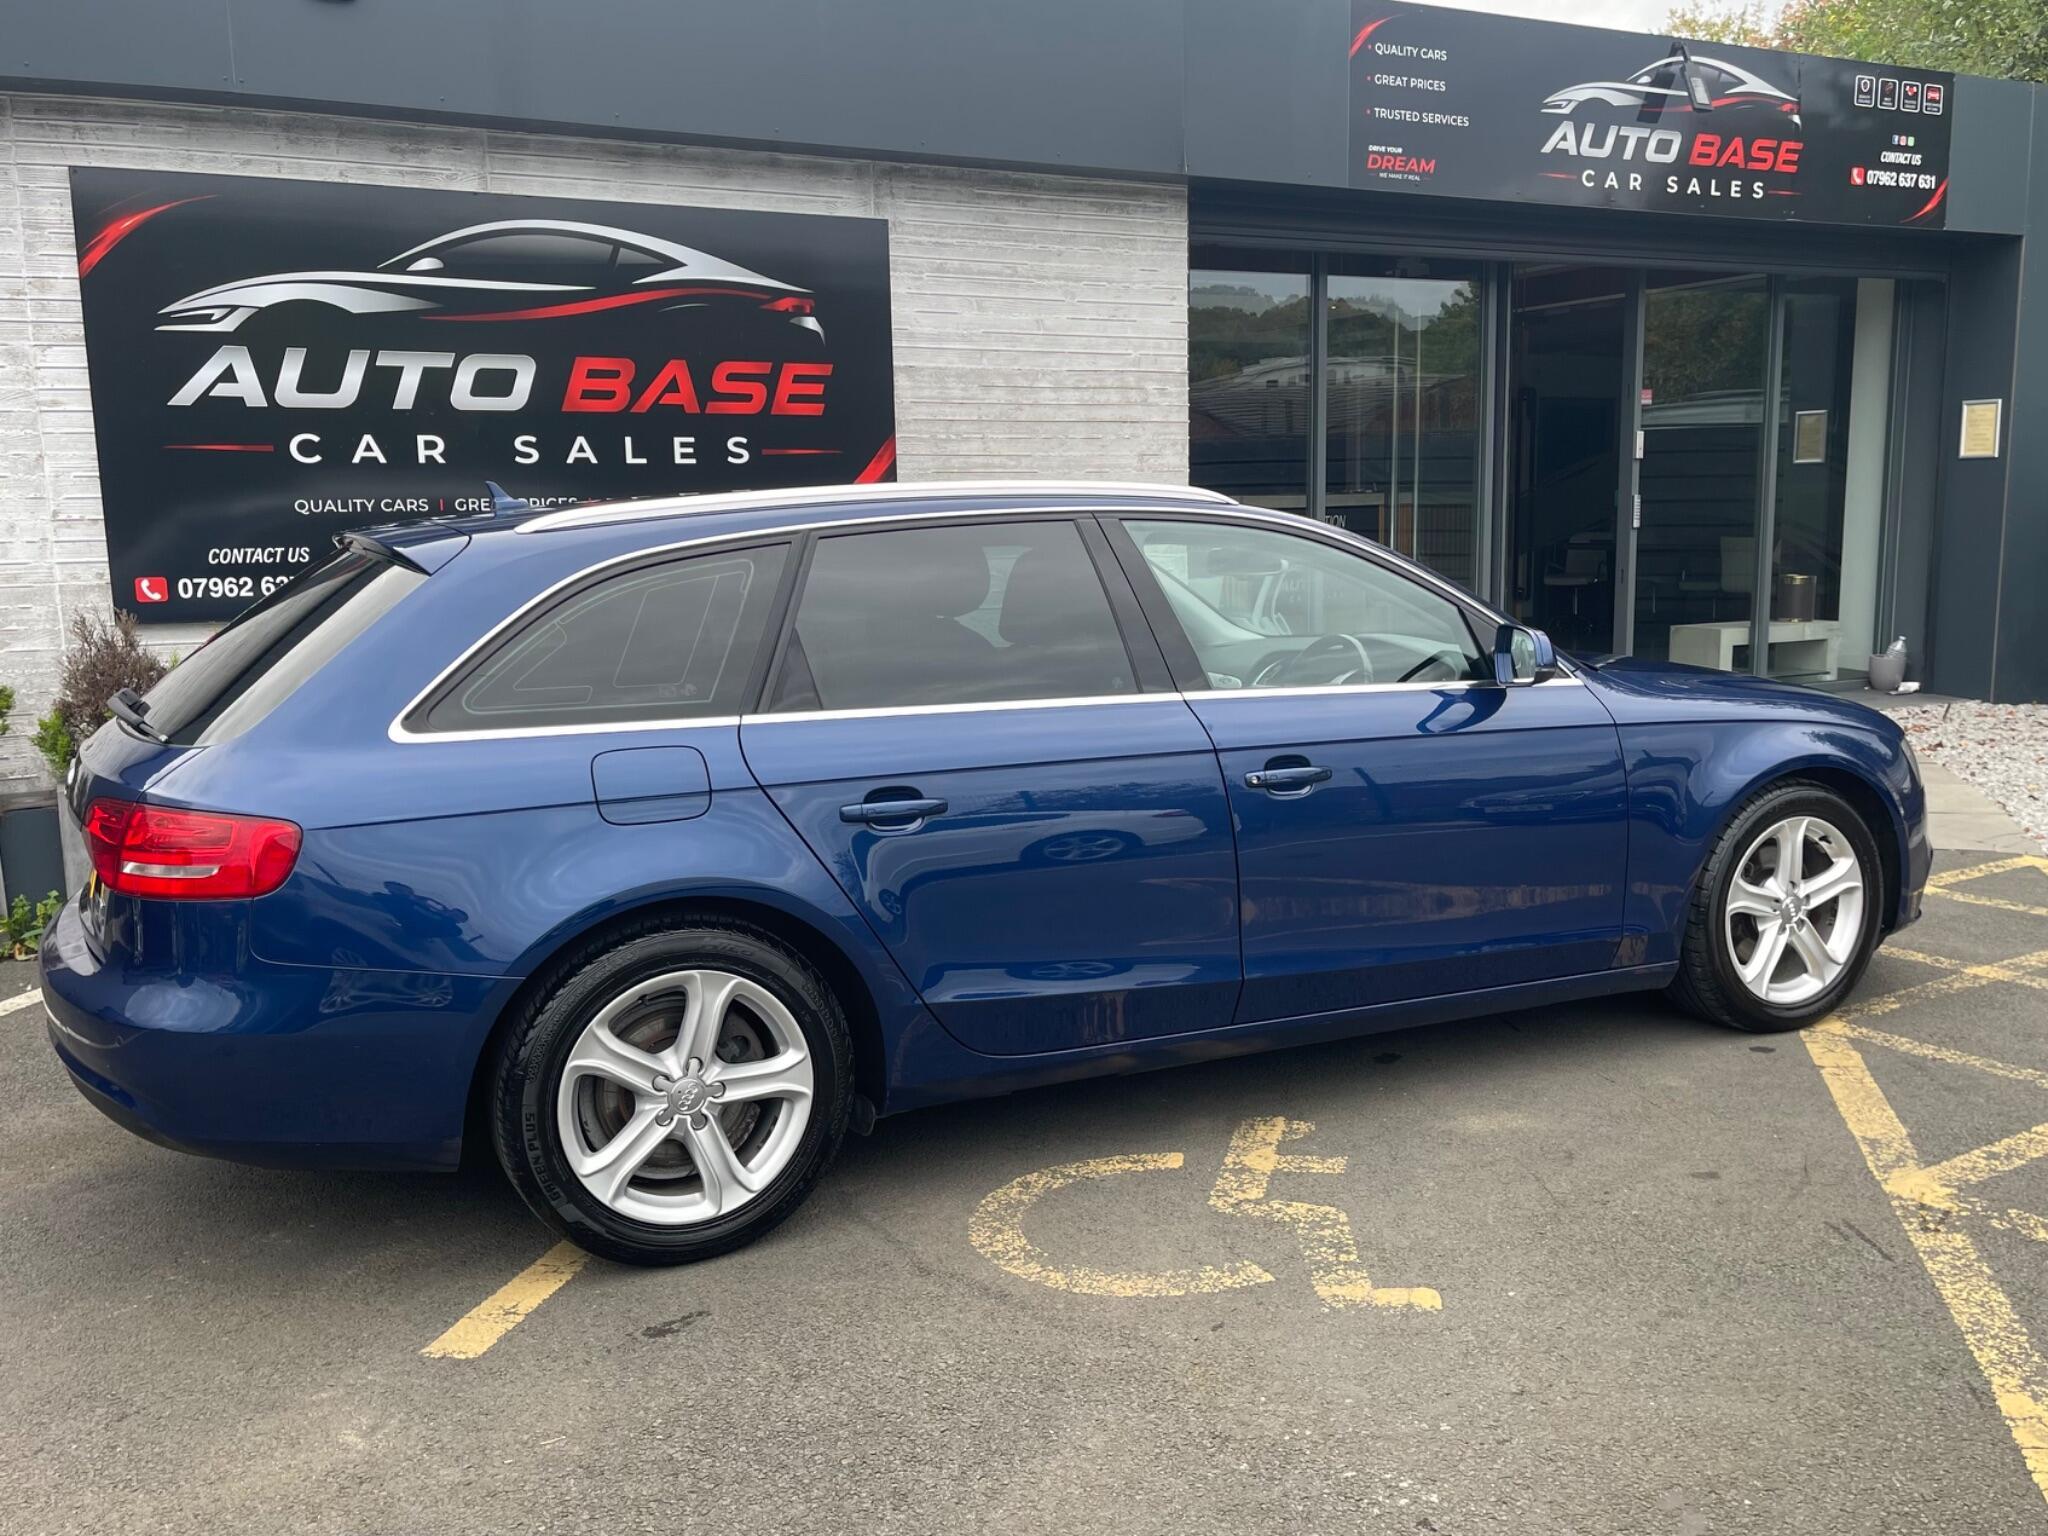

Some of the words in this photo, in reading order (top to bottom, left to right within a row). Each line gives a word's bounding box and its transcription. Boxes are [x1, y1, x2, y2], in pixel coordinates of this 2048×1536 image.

[1375, 43, 1418, 57] QUALITY
[1420, 48, 1447, 61] CARS
[1374, 74, 1408, 87] GREAT
[1410, 78, 1446, 91] PRICES
[1374, 107, 1420, 121] TRUSTED
[1422, 113, 1469, 127] SERVICES
[1540, 120, 1682, 163] AUTO
[1688, 132, 1804, 173] BASE
[1367, 154, 1436, 174] DREAM
[1881, 151, 1911, 164] CONTACT
[1911, 154, 1922, 166] US
[1581, 169, 1642, 191] CAR
[1666, 175, 1764, 199] SALES
[1867, 170, 1897, 186] 07962
[1898, 172, 1917, 188] 637
[1918, 174, 1936, 190] 631
[166, 345, 536, 411] AUTO
[561, 356, 833, 416] BASE
[289, 433, 446, 464] CAR
[513, 434, 750, 465] SALES
[294, 498, 375, 515] QUALITY
[380, 498, 429, 512] CARS
[454, 498, 493, 512] GRE
[208, 548, 284, 565] CONTACT
[287, 547, 310, 562] US
[177, 577, 254, 599] 07962
[525, 1112, 539, 1152] PLUS
